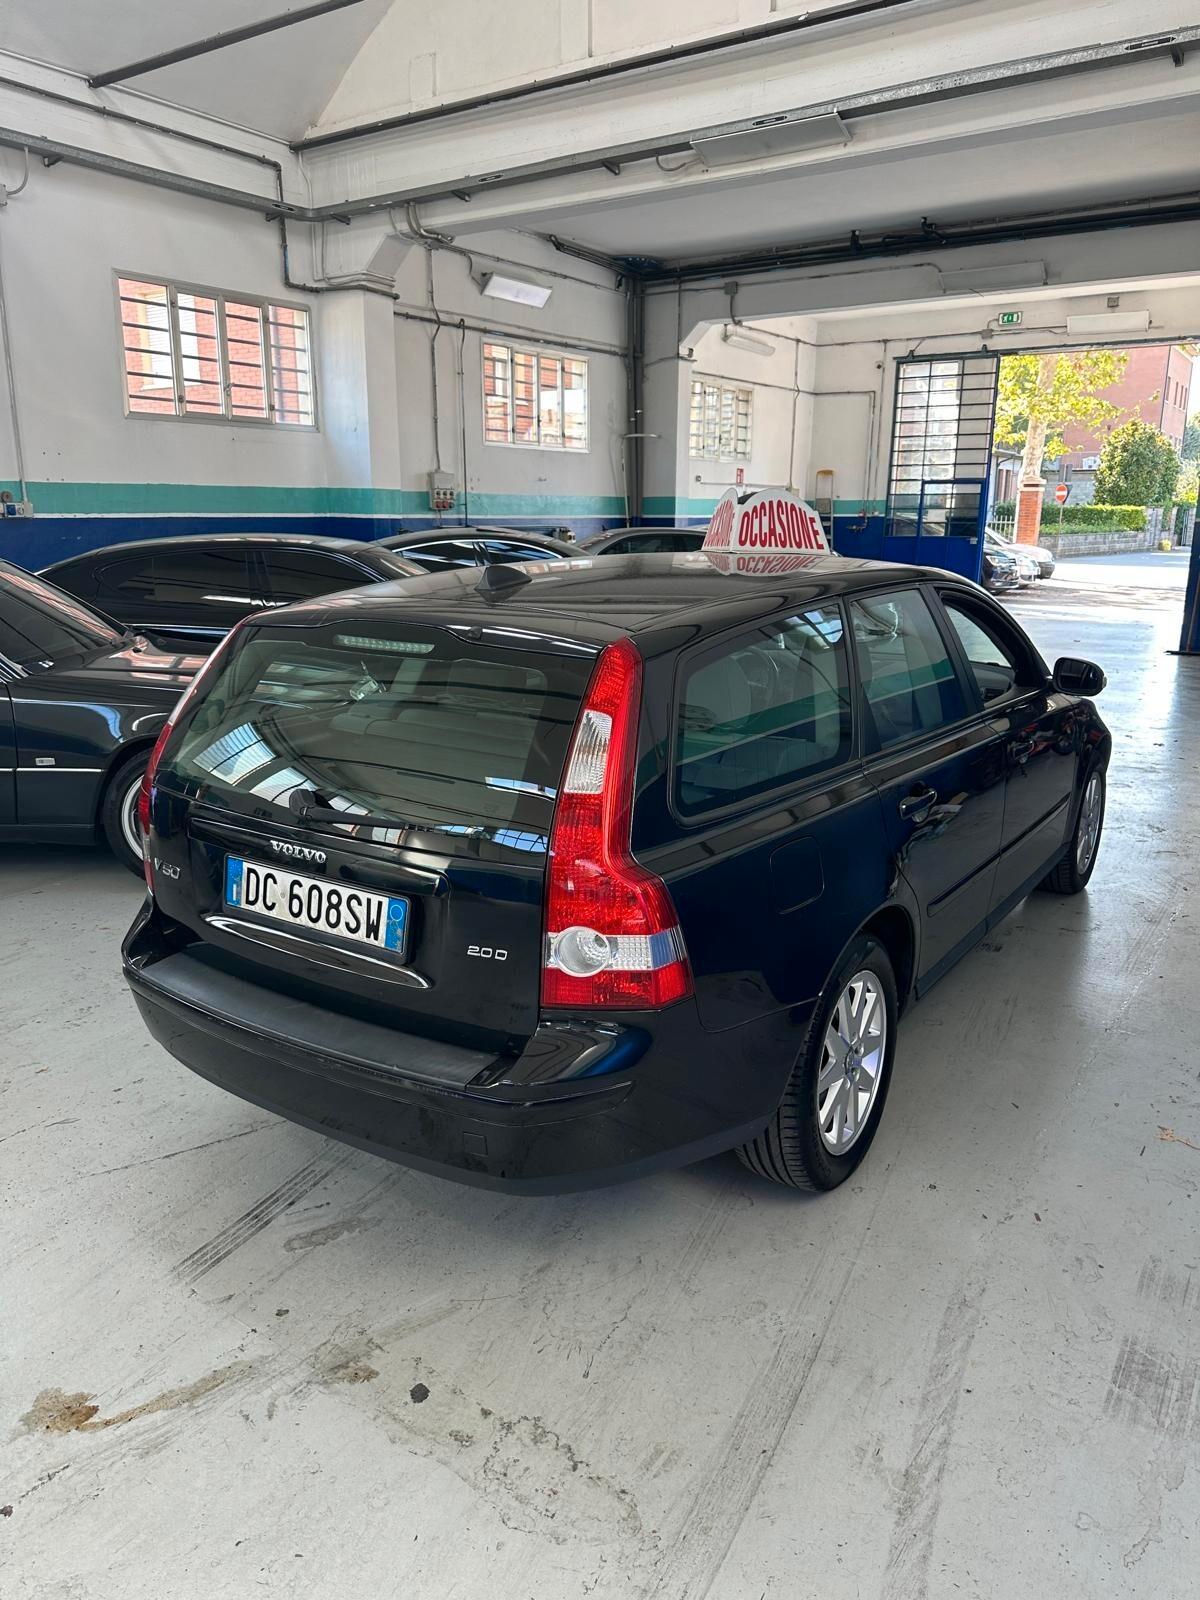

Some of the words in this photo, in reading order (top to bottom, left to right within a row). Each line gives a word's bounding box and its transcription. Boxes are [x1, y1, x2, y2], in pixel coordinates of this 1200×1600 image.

[738, 499, 824, 550] OCCASIONE
[270, 839, 327, 864] VOLVO
[154, 857, 181, 880] V50
